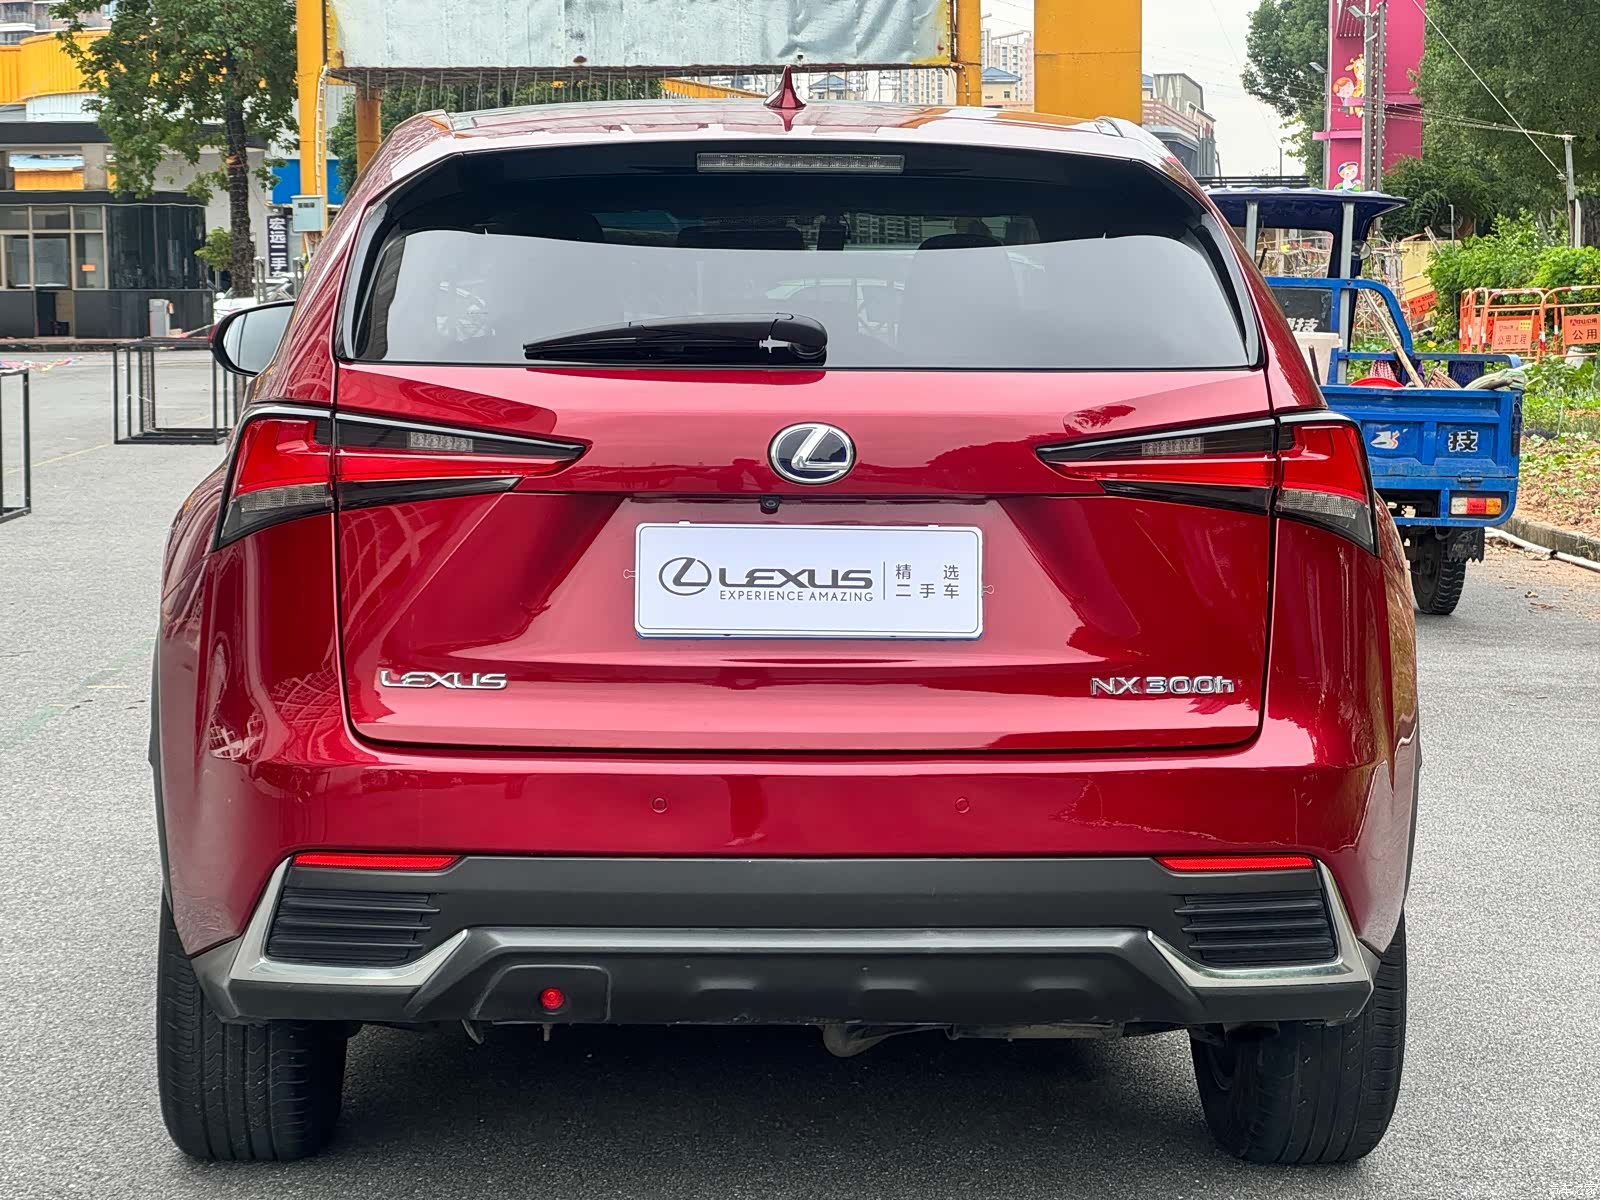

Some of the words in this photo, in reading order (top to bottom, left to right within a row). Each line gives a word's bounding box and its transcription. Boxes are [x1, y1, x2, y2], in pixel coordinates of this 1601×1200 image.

[1498, 333, 1527, 345] 公用工程
[1572, 328, 1598, 340] 公用
[1448, 430, 1478, 452] 技
[718, 568, 874, 589] LEXUS
[719, 590, 804, 601] EXPERIENCE
[809, 592, 874, 602] AMAZING
[895, 583, 960, 599] 二手车
[380, 670, 507, 690] LEXUS
[1091, 676, 1141, 695] NX
[1145, 676, 1235, 695] 300h
